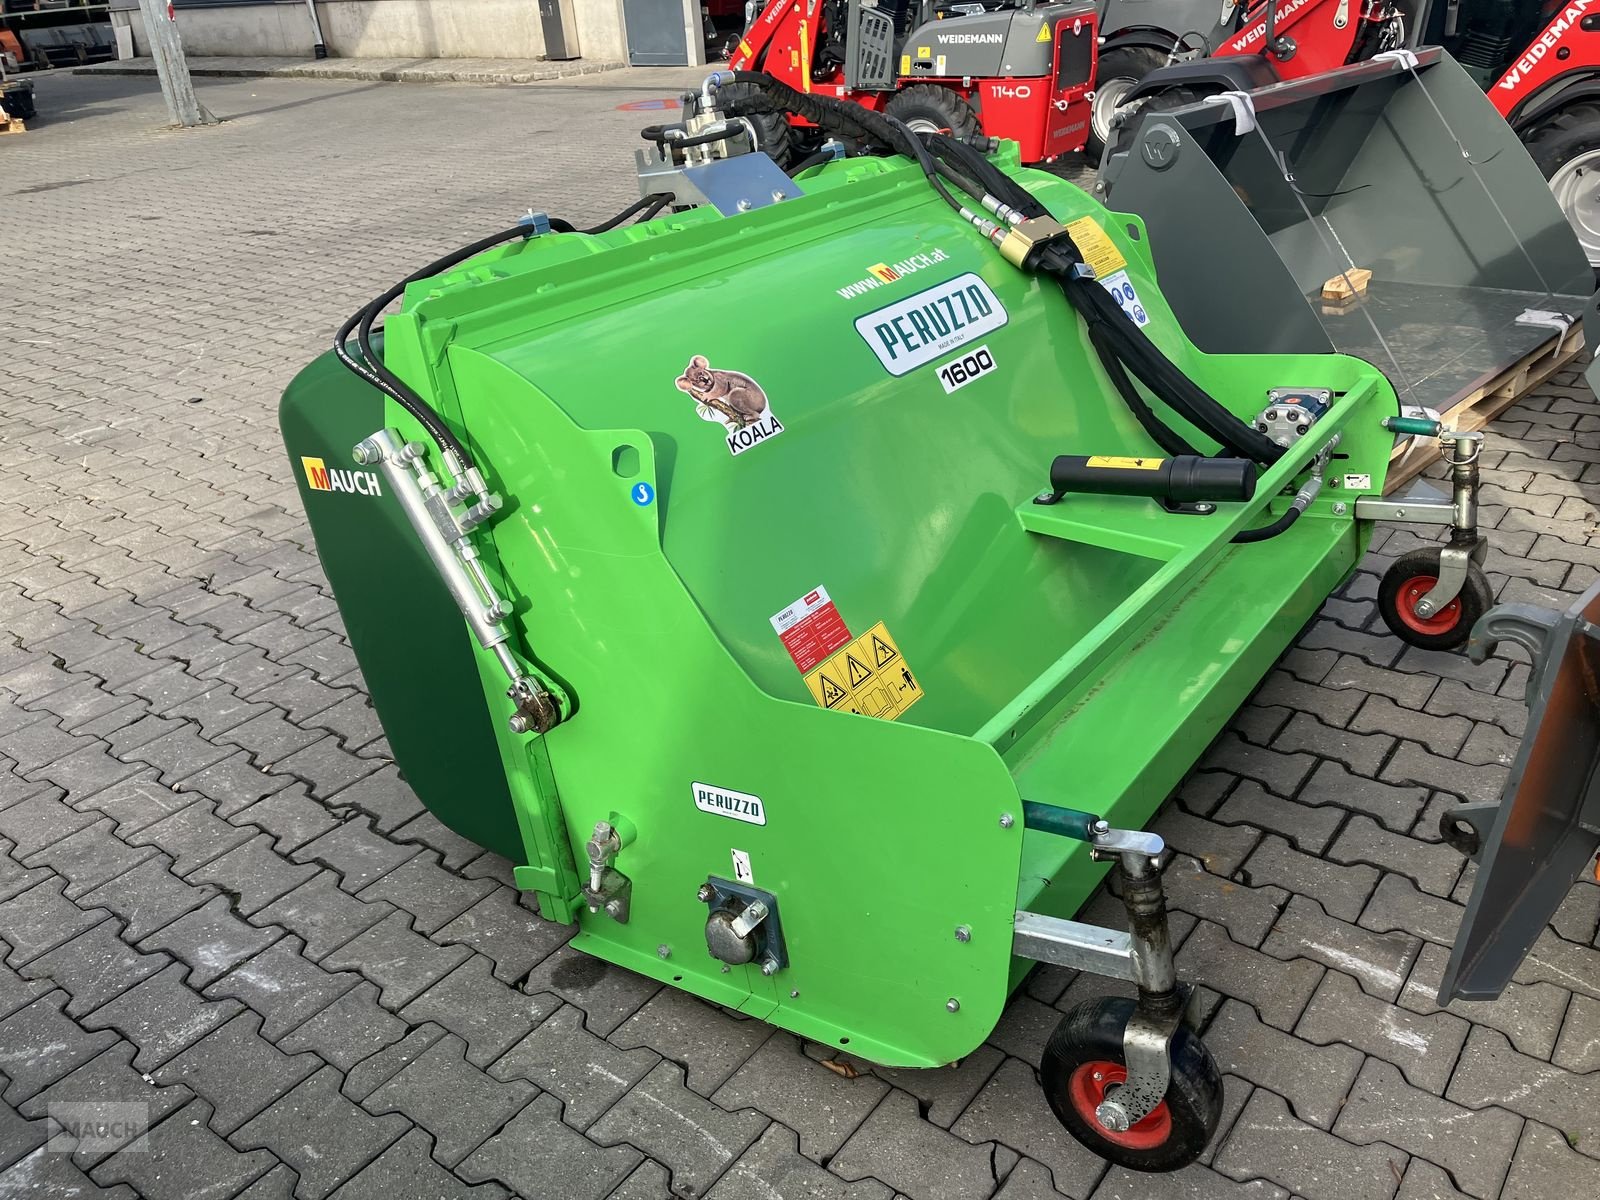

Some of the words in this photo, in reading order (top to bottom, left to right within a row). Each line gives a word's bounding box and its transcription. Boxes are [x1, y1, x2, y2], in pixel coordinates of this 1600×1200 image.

[937, 34, 1003, 44] WEIDEMANN
[991, 85, 1031, 98] 1140
[836, 248, 950, 300] www.MAUCH.at
[873, 284, 993, 360] PERUZZO
[940, 349, 993, 388] 1600
[727, 416, 783, 453] KOALA
[310, 467, 382, 497] MAUCH
[698, 789, 759, 817] PERUZZO
